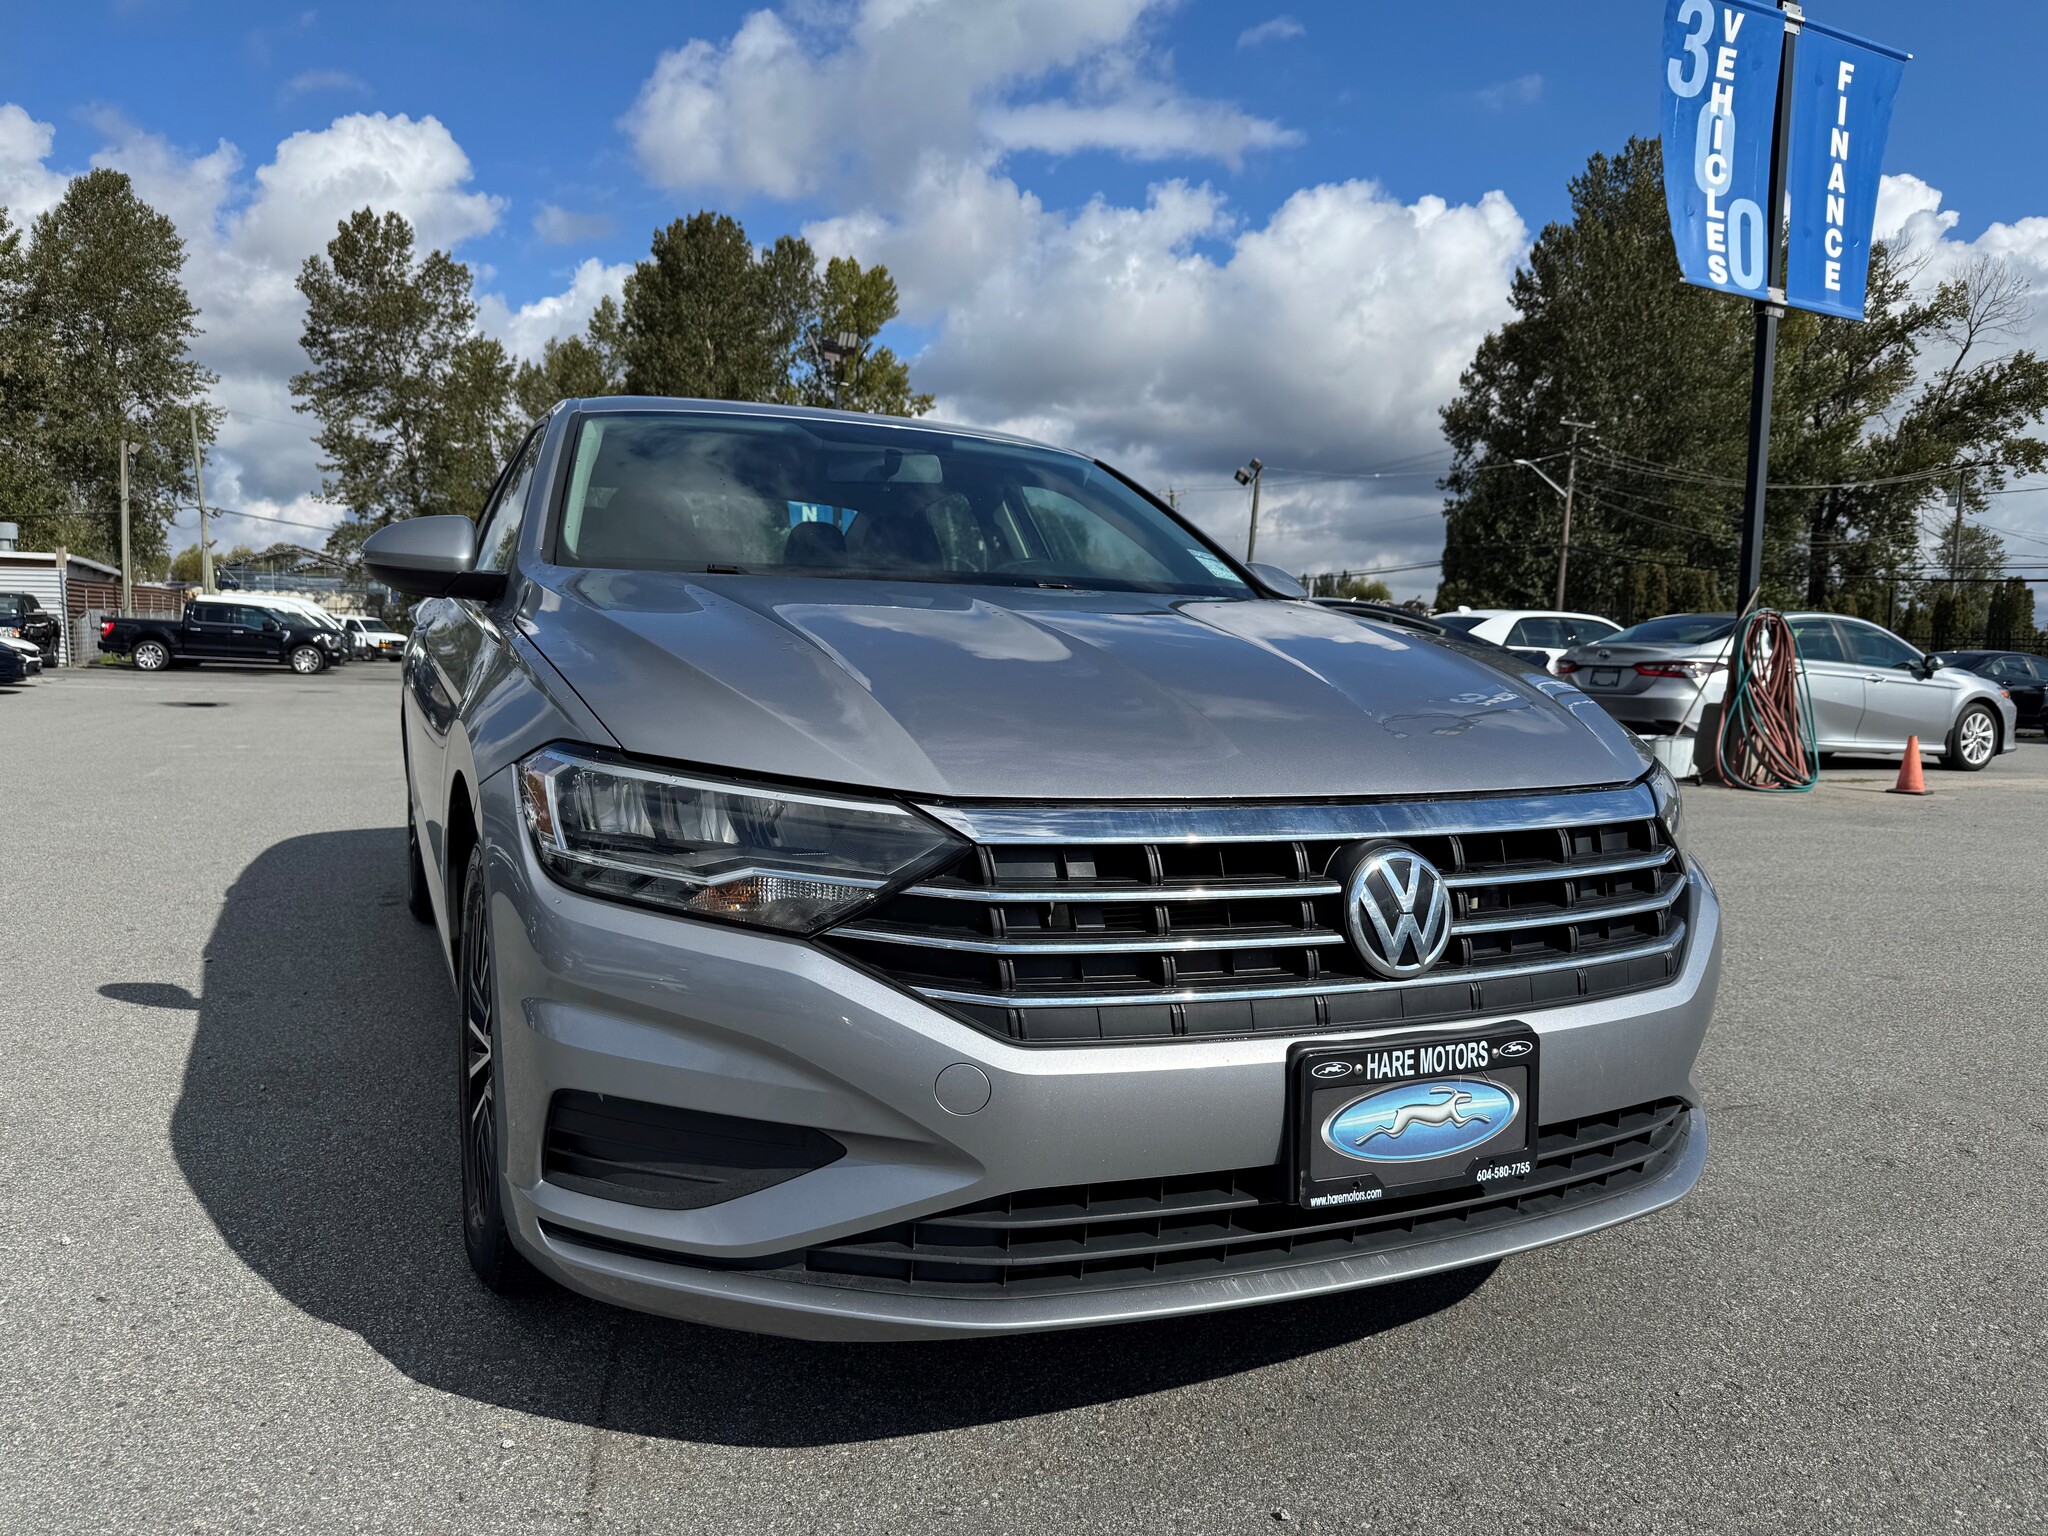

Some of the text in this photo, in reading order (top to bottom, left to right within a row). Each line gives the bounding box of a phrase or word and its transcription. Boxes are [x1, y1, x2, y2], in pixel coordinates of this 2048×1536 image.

[1704, 8, 1745, 285] VEHICLES
[1824, 60, 1855, 291] FINANCE
[1366, 1040, 1489, 1080] HARE MOTORS
[1476, 1161, 1531, 1183] 604-580-7755
[1310, 1187, 1383, 1208] www.haremotors.com
